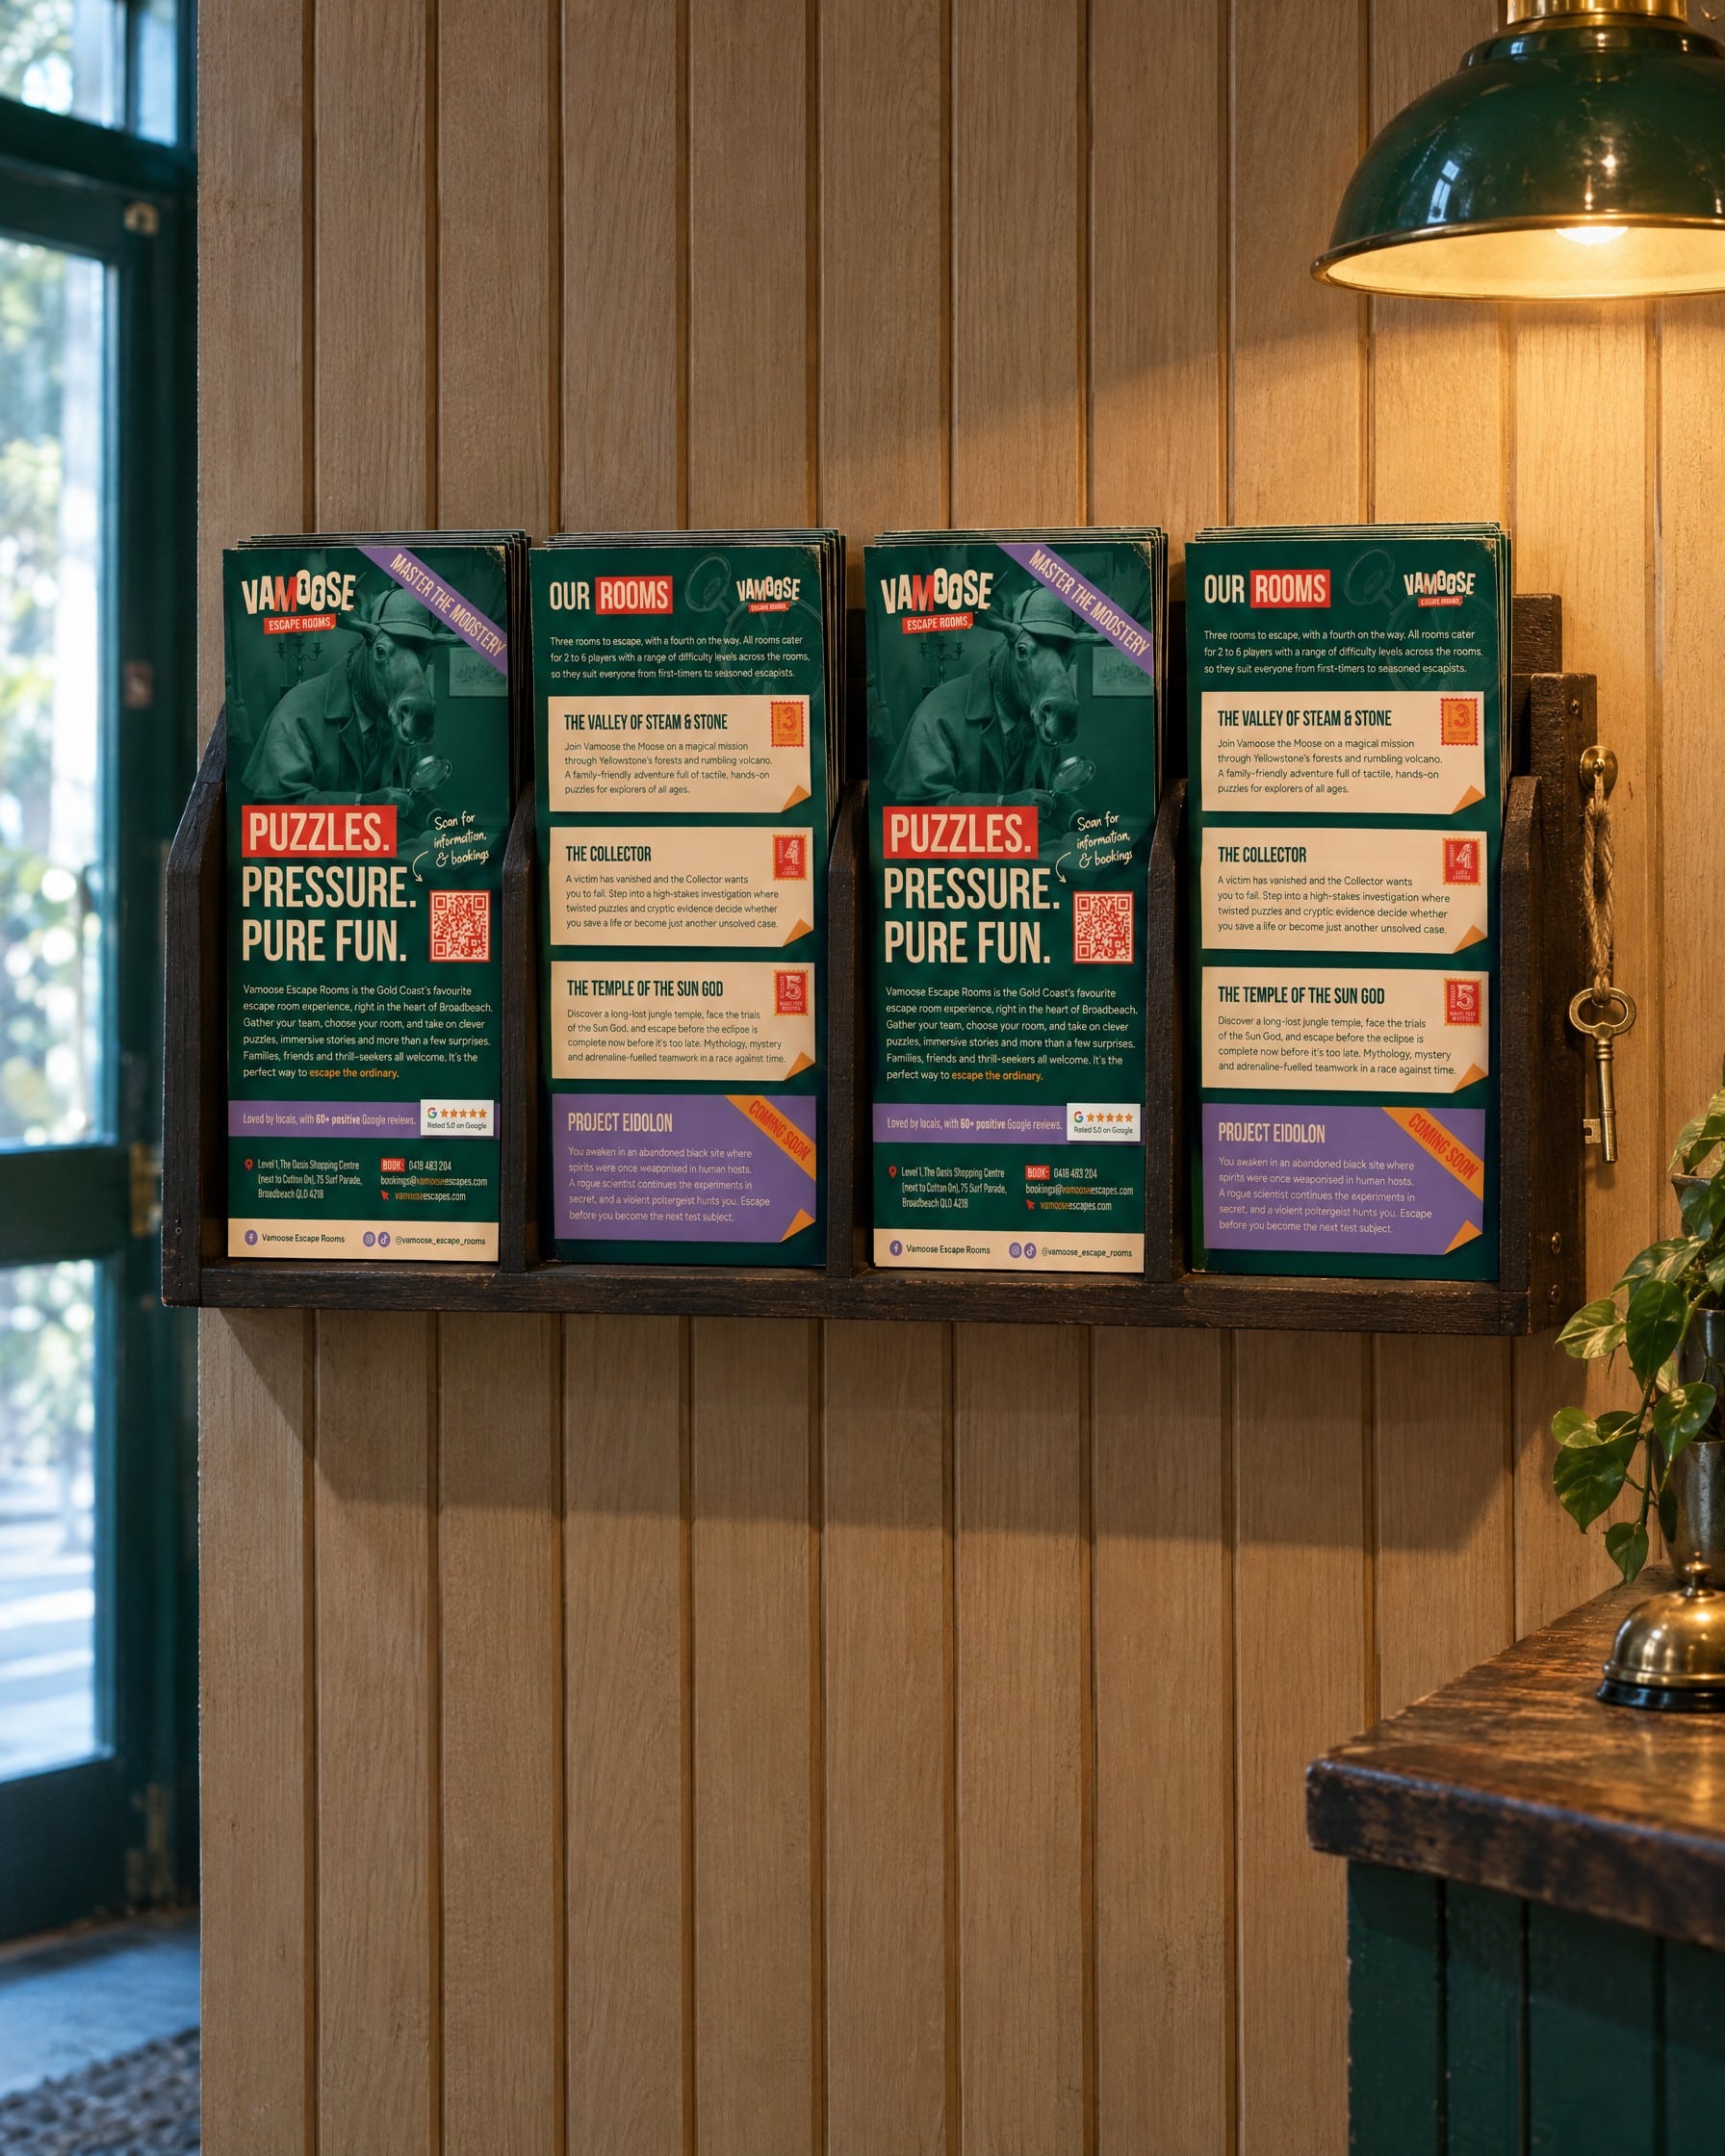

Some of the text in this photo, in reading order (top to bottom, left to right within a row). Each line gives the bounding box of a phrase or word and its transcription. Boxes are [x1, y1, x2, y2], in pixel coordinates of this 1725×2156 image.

[735, 576, 801, 602] VAMOOSE
[881, 567, 993, 614] VAMOOSE
[1204, 574, 1326, 603] OUR ROOMS
[1403, 569, 1476, 595] VAMOOSE
[241, 570, 356, 614] VAMOOSE
[550, 580, 668, 610] OUR ROOMS
[389, 553, 506, 656] MASTER THE MOOSTERY
[1029, 550, 1150, 656] MASTER THE MOOSTERY
[269, 616, 331, 631] ESCAPE ROOMS
[907, 616, 967, 630] ESCAPE ROOMS
[1203, 630, 1228, 640] Three
[1257, 630, 1268, 640] to
[1268, 632, 1301, 642] escape,
[1301, 629, 1321, 640] with
[1322, 630, 1328, 640] a
[1329, 629, 1356, 640] fourth
[1357, 630, 1369, 640] on
[1370, 629, 1386, 640] the
[1386, 630, 1406, 642] way.
[1407, 629, 1420, 640] All
[1421, 630, 1450, 640] rooms
[1451, 629, 1476, 640] cater
[564, 714, 728, 730] THE VALLEY OF STEAM & STONE
[783, 706, 797, 731] 3
[1218, 709, 1391, 726] THE VALLEY OF STEAM & STONE
[1454, 704, 1470, 728] 3
[1217, 754, 1251, 766] through
[1312, 753, 1343, 763] forests
[1344, 754, 1362, 763] and
[1363, 754, 1403, 765] rumbling
[1404, 754, 1443, 764] volcano.
[434, 809, 476, 831] Scan for
[1077, 810, 1120, 832] Scan for
[250, 812, 389, 851] PUZZLES.
[891, 814, 1031, 853] PUZZLES.
[435, 848, 489, 867] & bookings
[566, 846, 651, 861] THE COLLECTOR
[785, 839, 800, 864] 4
[1079, 849, 1133, 868] & bookings
[1219, 847, 1306, 862] THE COLLECTOR
[1455, 843, 1473, 869] 4
[243, 866, 417, 907] PRESSURE.
[565, 873, 749, 885] A victim has vanished and the Collector wants
[885, 868, 1060, 909] PRESSURE.
[243, 919, 406, 962] PURE FUN.
[886, 921, 1050, 963] PURE FUN.
[243, 984, 285, 994] Vamoose
[286, 984, 319, 997] Escape
[320, 984, 350, 995] Rooms
[351, 984, 359, 995] is
[360, 985, 375, 996] the
[376, 985, 398, 996] Gold
[432, 985, 473, 996] favourite
[567, 980, 723, 996] THE TEMPLE OF THE SUN GOD
[785, 975, 802, 1000] 5
[1218, 986, 1384, 1004] THE TEMPLE OF THE SUN GOD
[1456, 984, 1475, 1010] 5
[886, 1019, 1129, 1033] Gather your team, choose your room, and take on clever
[243, 1066, 399, 1080] perfect way to escape the ordinary.
[427, 1107, 438, 1118] G
[1073, 1111, 1084, 1123] G
[569, 1113, 672, 1132] PROJECT EIDOLON
[749, 1100, 811, 1162] COMING SOON
[1111, 1126, 1133, 1136] Google
[1219, 1122, 1325, 1142] PROJECT EIDOLON
[1408, 1113, 1479, 1180] COMING SOON
[1219, 1219, 1394, 1236] before you become the next test subject.
[261, 1233, 346, 1245] Vamoose Escape Rooms
[395, 1235, 487, 1247] @vamoose_escape_rooms
[906, 1244, 991, 1256] Vamoose Escape Rooms
[1041, 1246, 1133, 1259] @vamoose_escape_rooms
